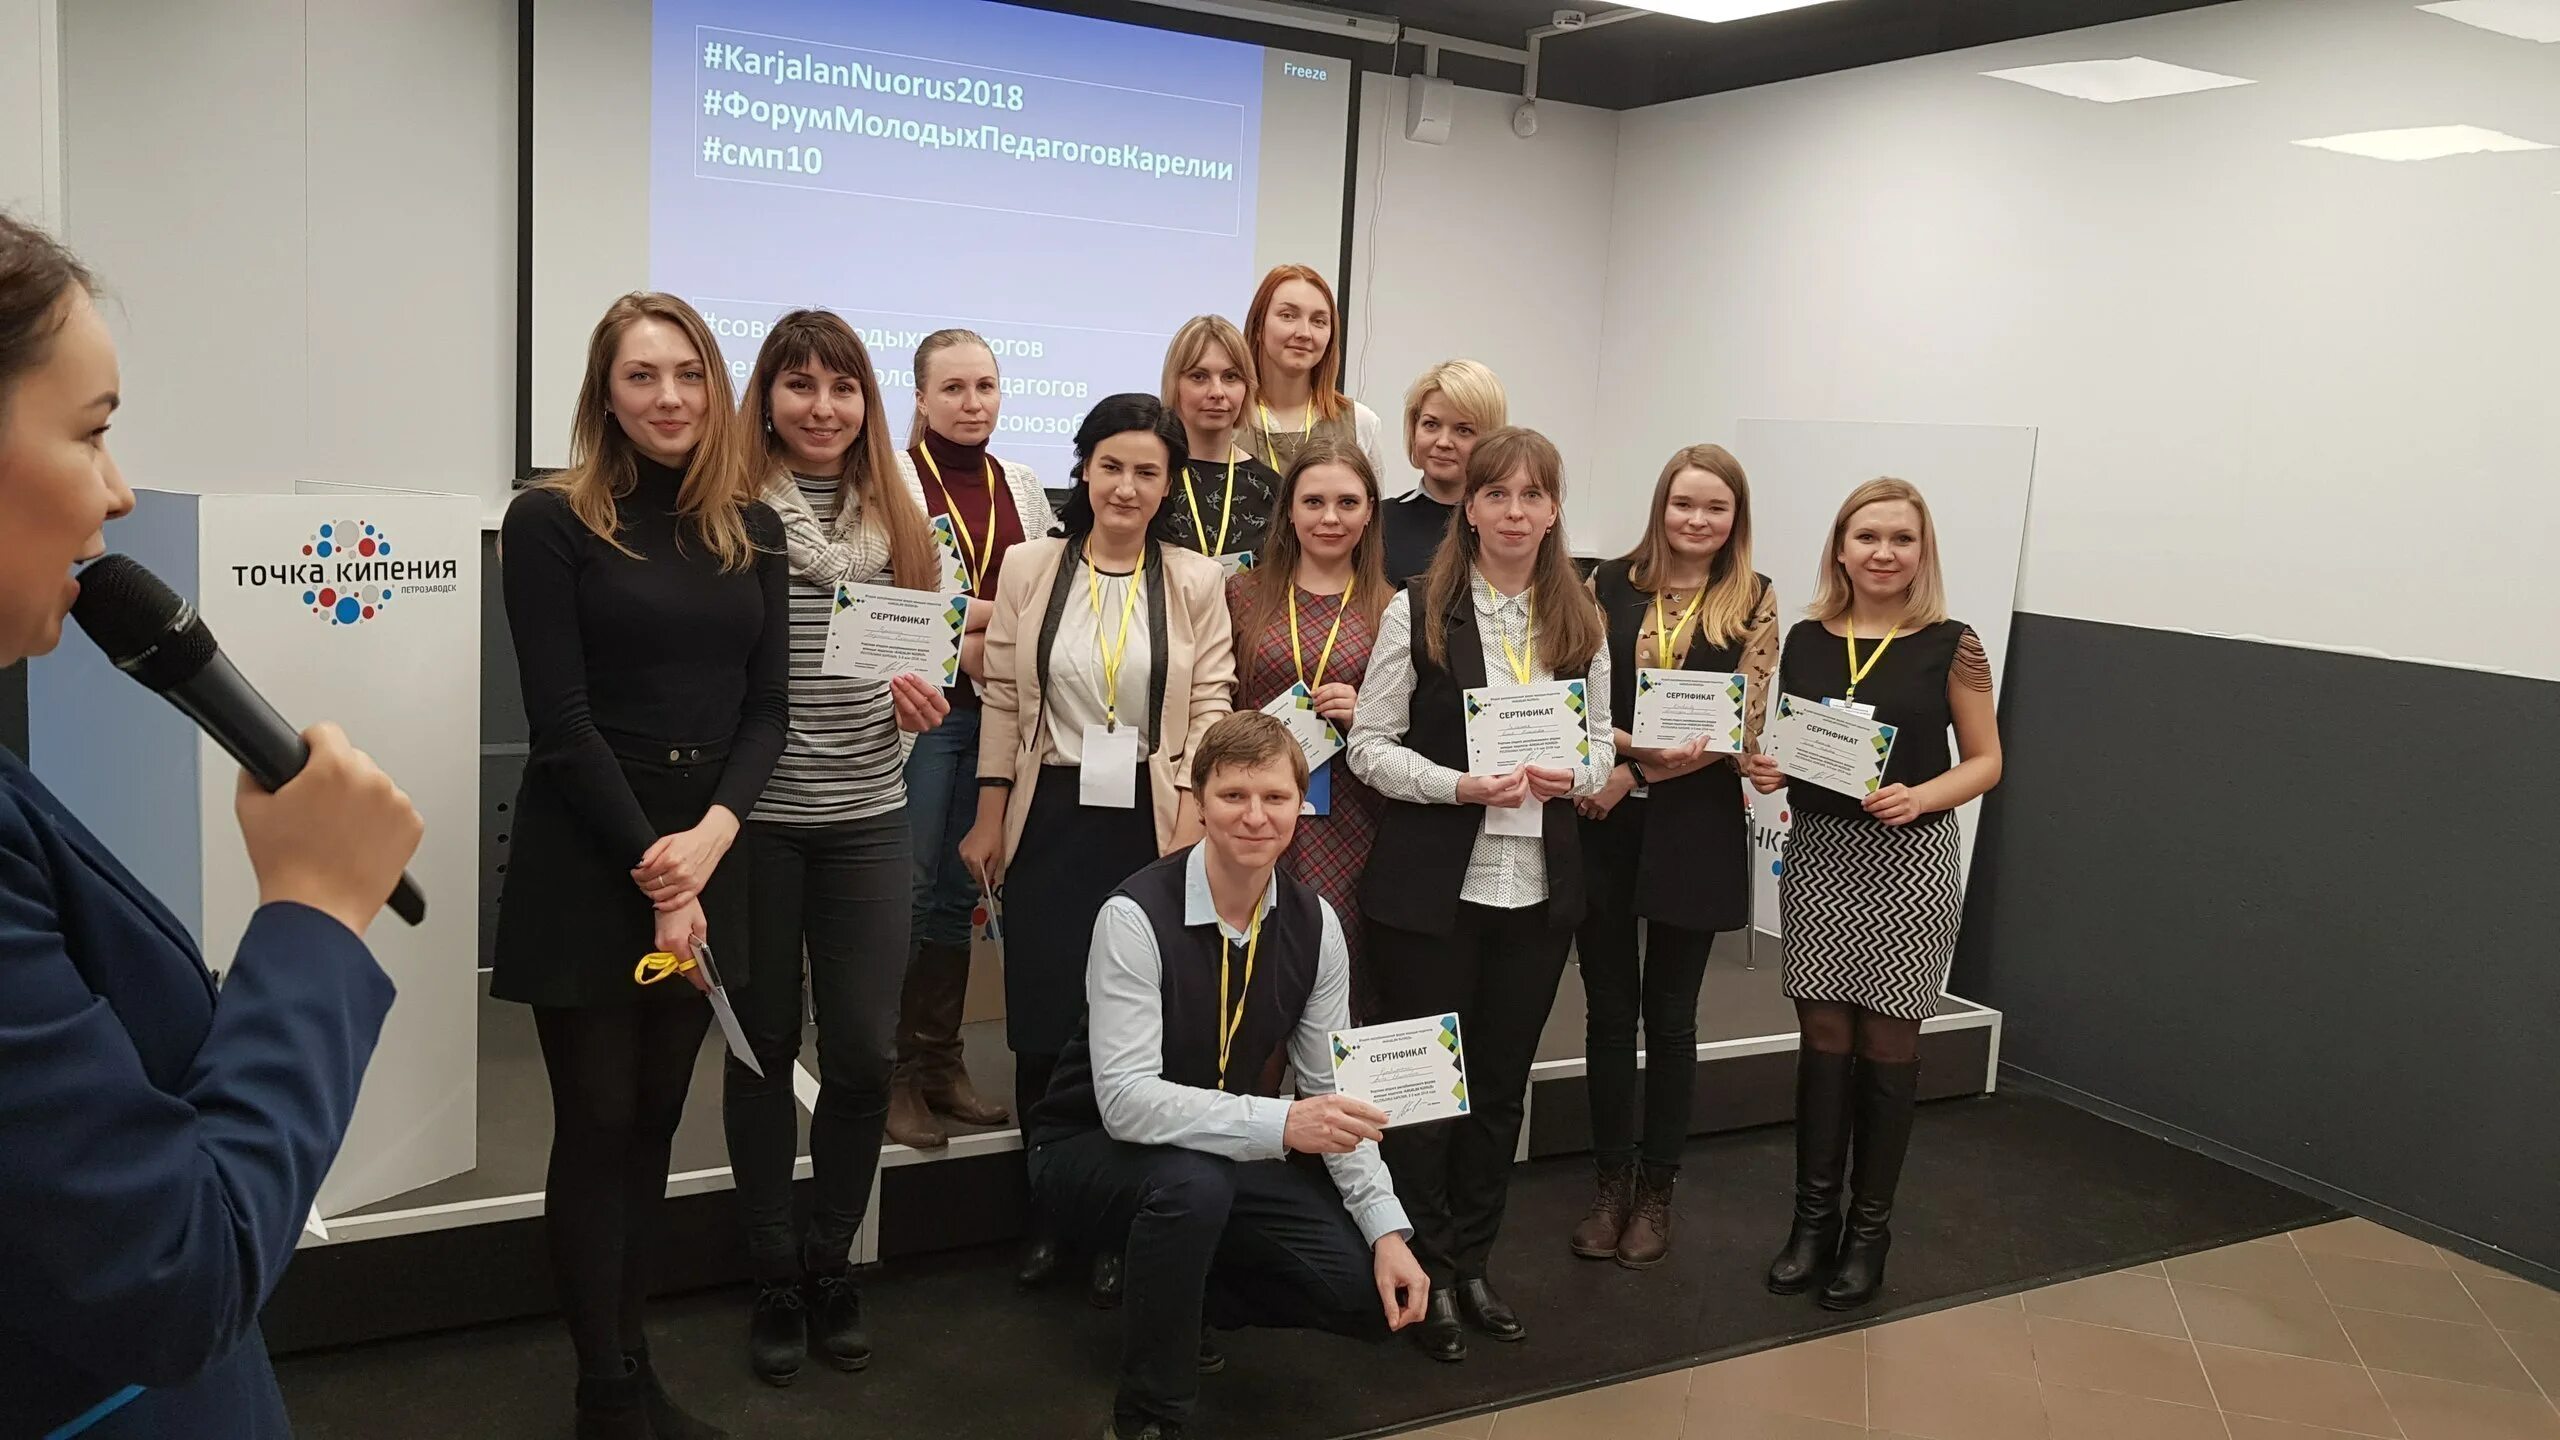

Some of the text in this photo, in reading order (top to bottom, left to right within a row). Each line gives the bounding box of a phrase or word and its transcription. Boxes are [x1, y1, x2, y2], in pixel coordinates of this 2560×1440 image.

[704, 42, 1024, 111] #KarjalanNuorus2018
[1284, 62, 1327, 81] Freeze
[703, 89, 1233, 181] #ФорумМолодыхПедагоговКарелии
[703, 136, 822, 174] #смп10
[232, 560, 457, 586] точка кипения
[401, 585, 457, 594] ПЕТРОЗАВОДСК
[870, 612, 931, 626] СЕРТИФИКАТ
[1666, 692, 1716, 701] СЕРТИФИКАТ
[1499, 707, 1555, 719] СЕРТИФИКАТ
[1806, 724, 1859, 745] СЕРТИФИКАТ
[1370, 1046, 1428, 1063] СЕРТИФИКАТ
